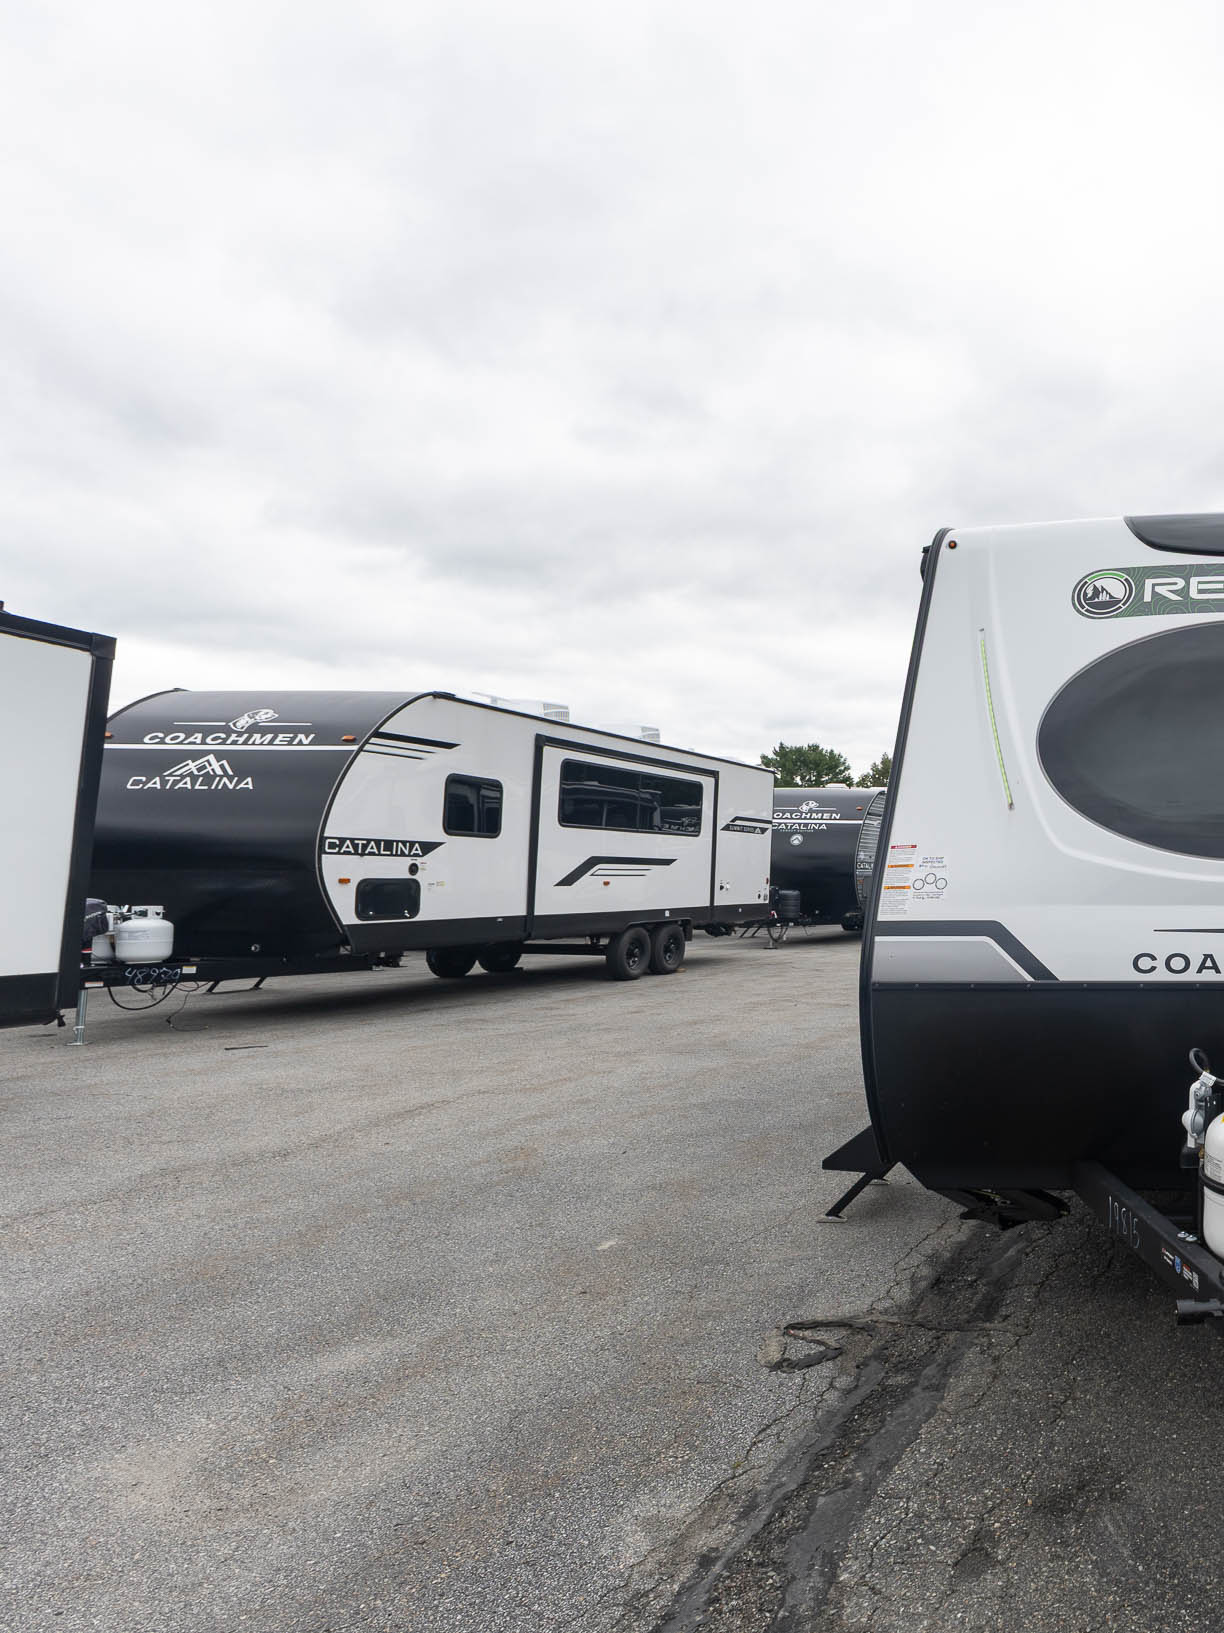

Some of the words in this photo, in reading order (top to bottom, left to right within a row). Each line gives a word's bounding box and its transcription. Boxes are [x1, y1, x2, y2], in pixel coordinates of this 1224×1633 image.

[143, 732, 316, 745] COACHMEN
[126, 776, 254, 790] CATALINA
[773, 812, 841, 820] OACHMEN
[324, 838, 424, 856] CATALINA
